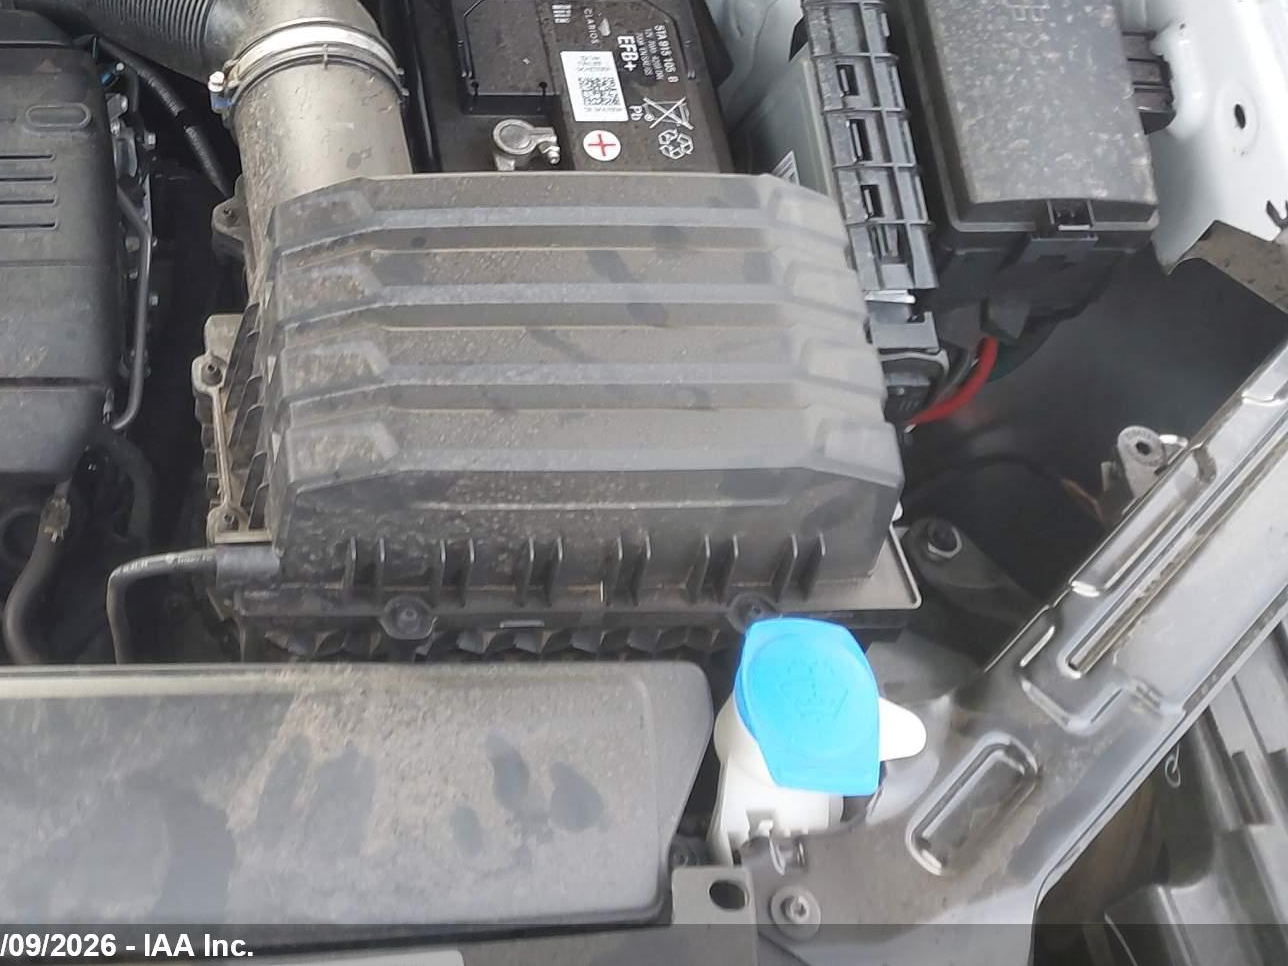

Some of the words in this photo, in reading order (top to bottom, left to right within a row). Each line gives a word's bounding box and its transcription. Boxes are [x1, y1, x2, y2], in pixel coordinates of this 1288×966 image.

[583, 8, 600, 44] CLARIOS
[617, 36, 639, 71] EFB+
[629, 105, 644, 121] Pb
